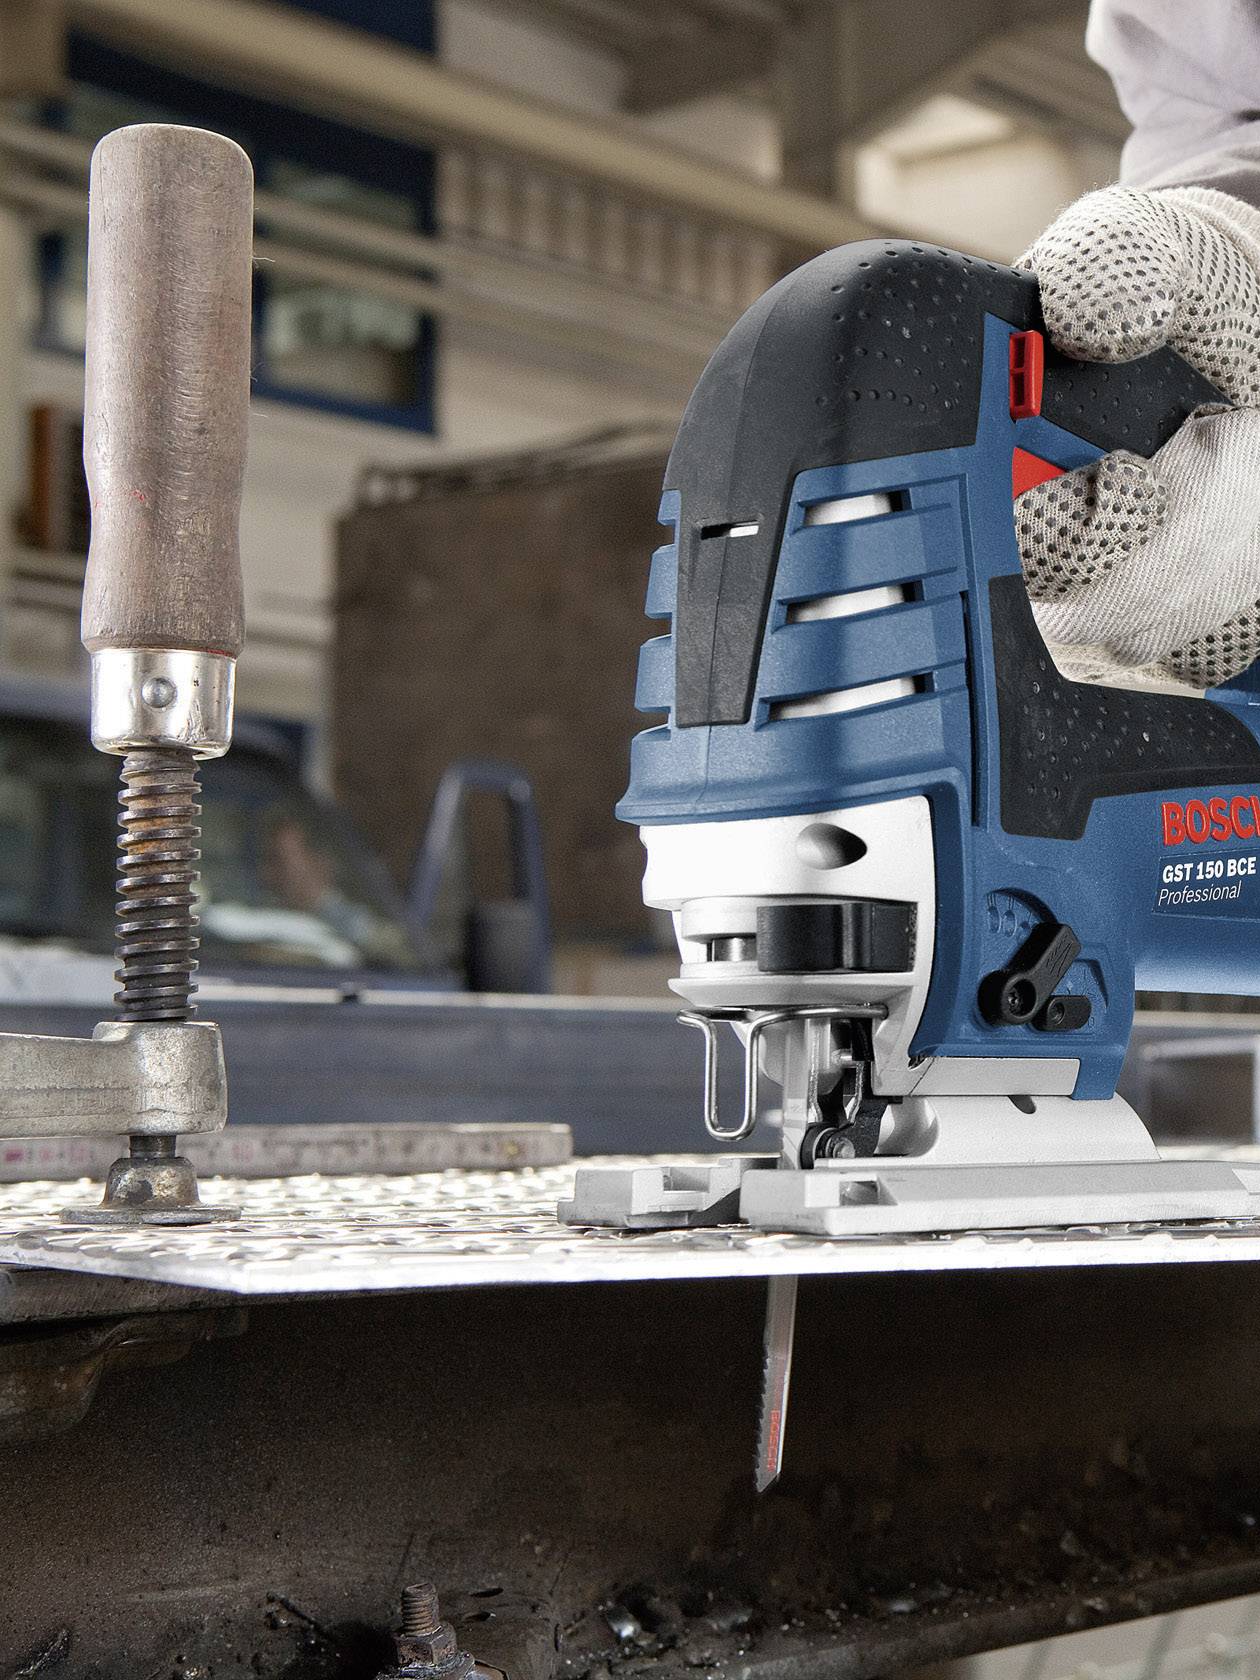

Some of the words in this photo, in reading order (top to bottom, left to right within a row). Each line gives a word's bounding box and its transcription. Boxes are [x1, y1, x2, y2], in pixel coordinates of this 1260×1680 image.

[1162, 864, 1194, 883] GST
[1196, 861, 1224, 880] 150
[1226, 857, 1257, 877] BCE
[1158, 880, 1242, 906] Professional
